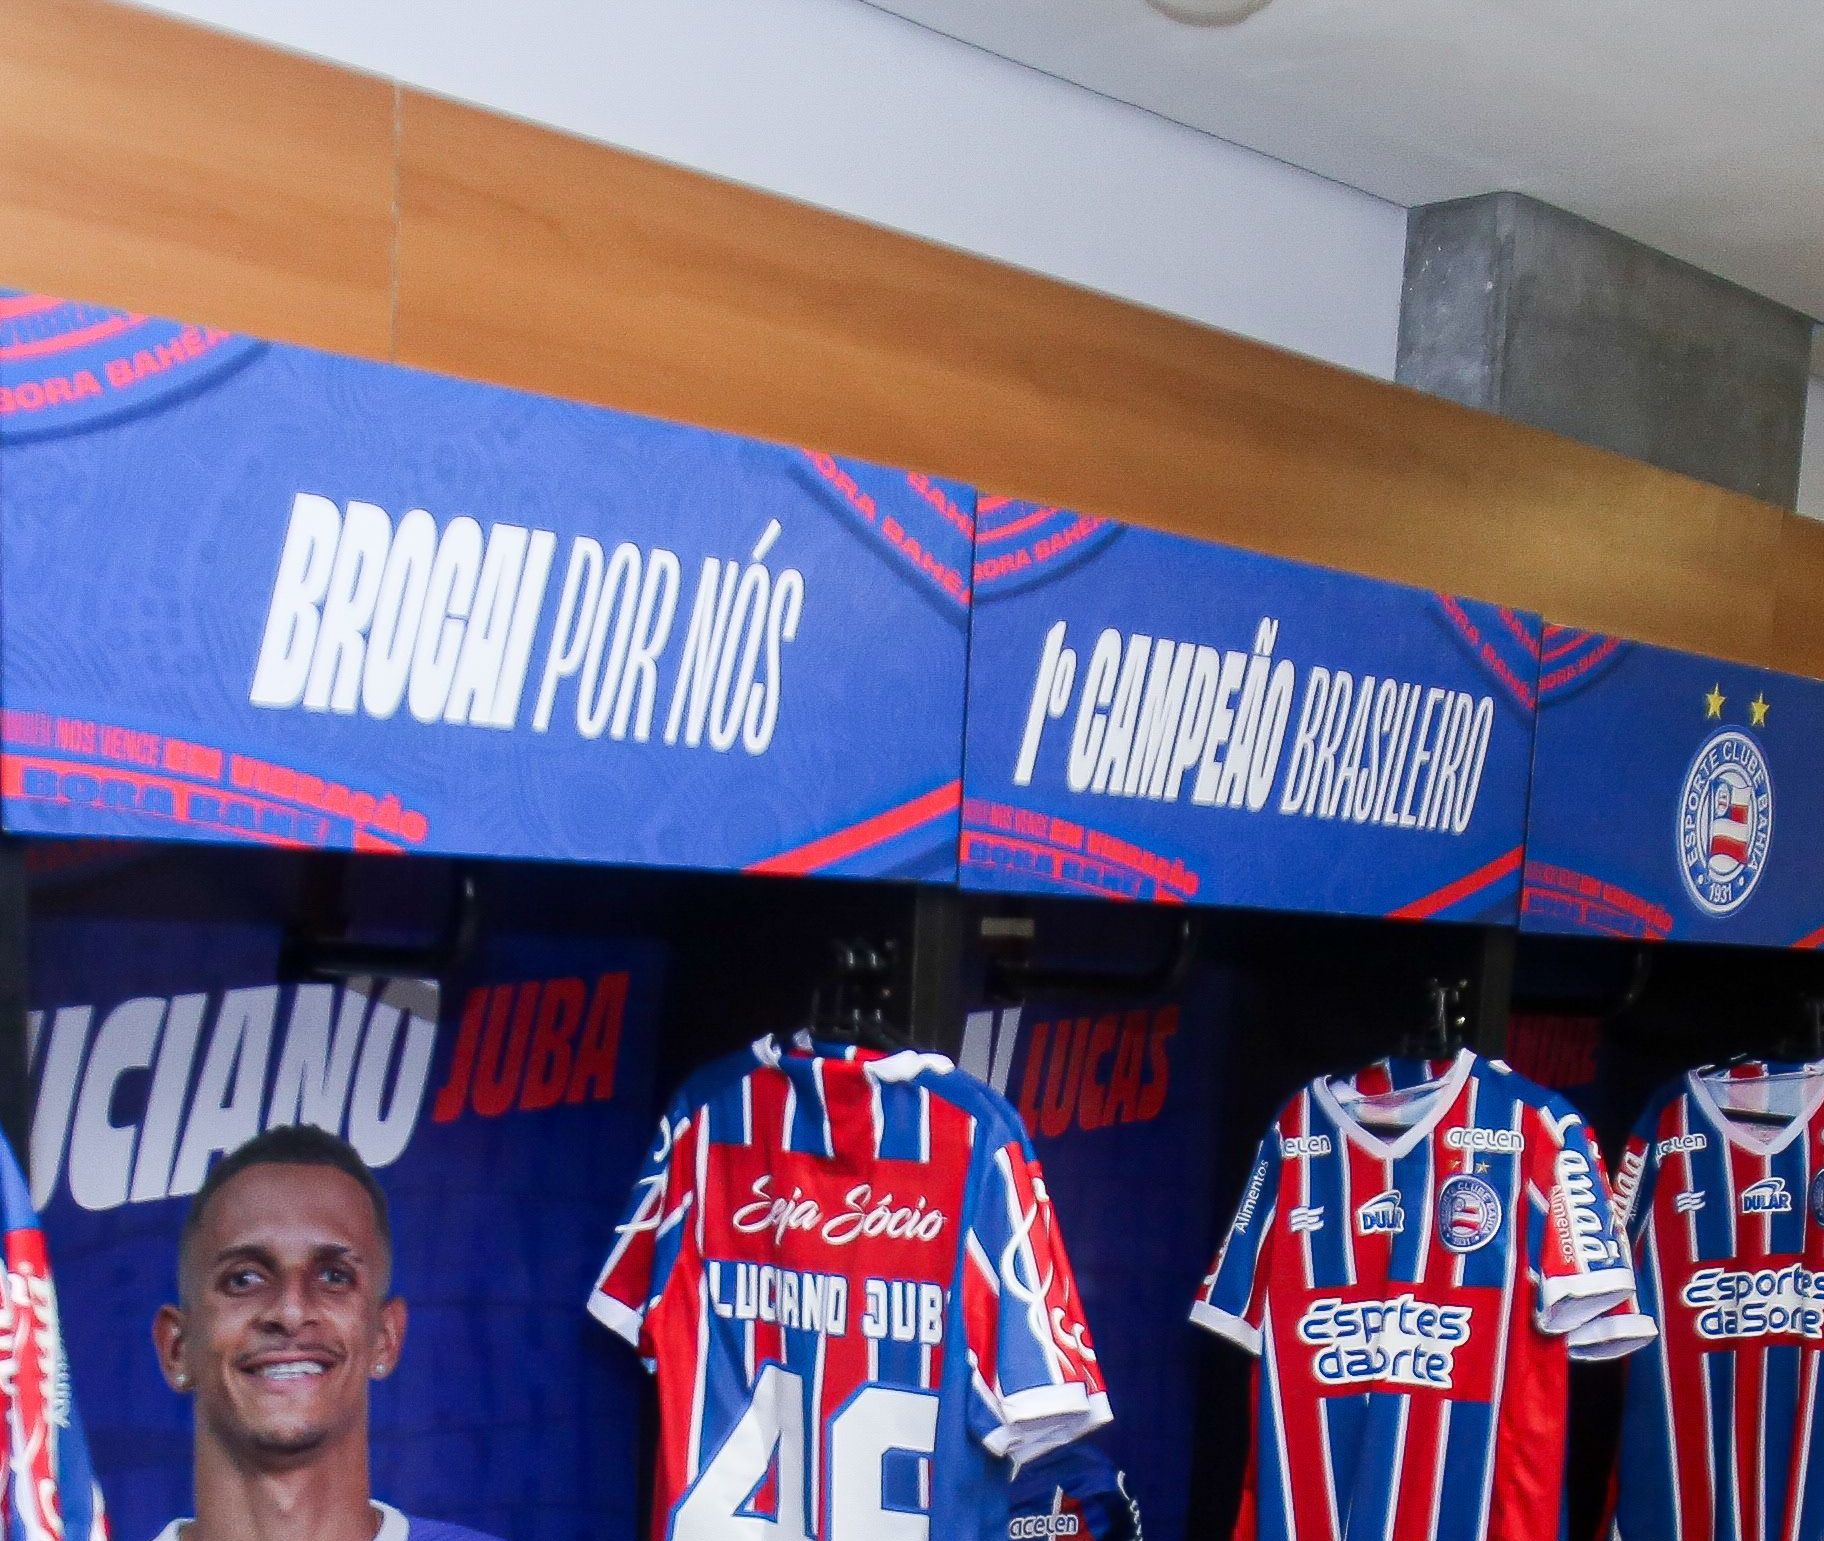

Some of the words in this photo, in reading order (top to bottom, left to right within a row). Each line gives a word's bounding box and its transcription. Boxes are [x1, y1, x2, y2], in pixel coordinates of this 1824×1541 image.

[249, 491, 556, 732] BROCAI
[532, 533, 682, 745] POR
[663, 518, 805, 757] NÓS
[1066, 616, 1297, 813] CAMPEÃO
[1280, 665, 1495, 836] BRASILEIRO
[1683, 747, 1720, 868] ESPORTE
[1722, 740, 1766, 789] CLUBE
[1746, 792, 1770, 872] BAHIA
[1708, 882, 1733, 905] 1931
[28, 977, 441, 1214] UCIANO
[431, 970, 630, 1124] JUBA
[1018, 1003, 1180, 1140] LUCAS
[1281, 1133, 1332, 1158] elen
[1446, 1127, 1525, 1153] acelen
[732, 1175, 820, 1247] Seja
[820, 1183, 948, 1247] Sócio
[1549, 1184, 1576, 1265] Alimentos
[862, 1276, 944, 1346] JUB
[1298, 1293, 1473, 1346] Esprtes
[1008, 1513, 1079, 1540] acelen
